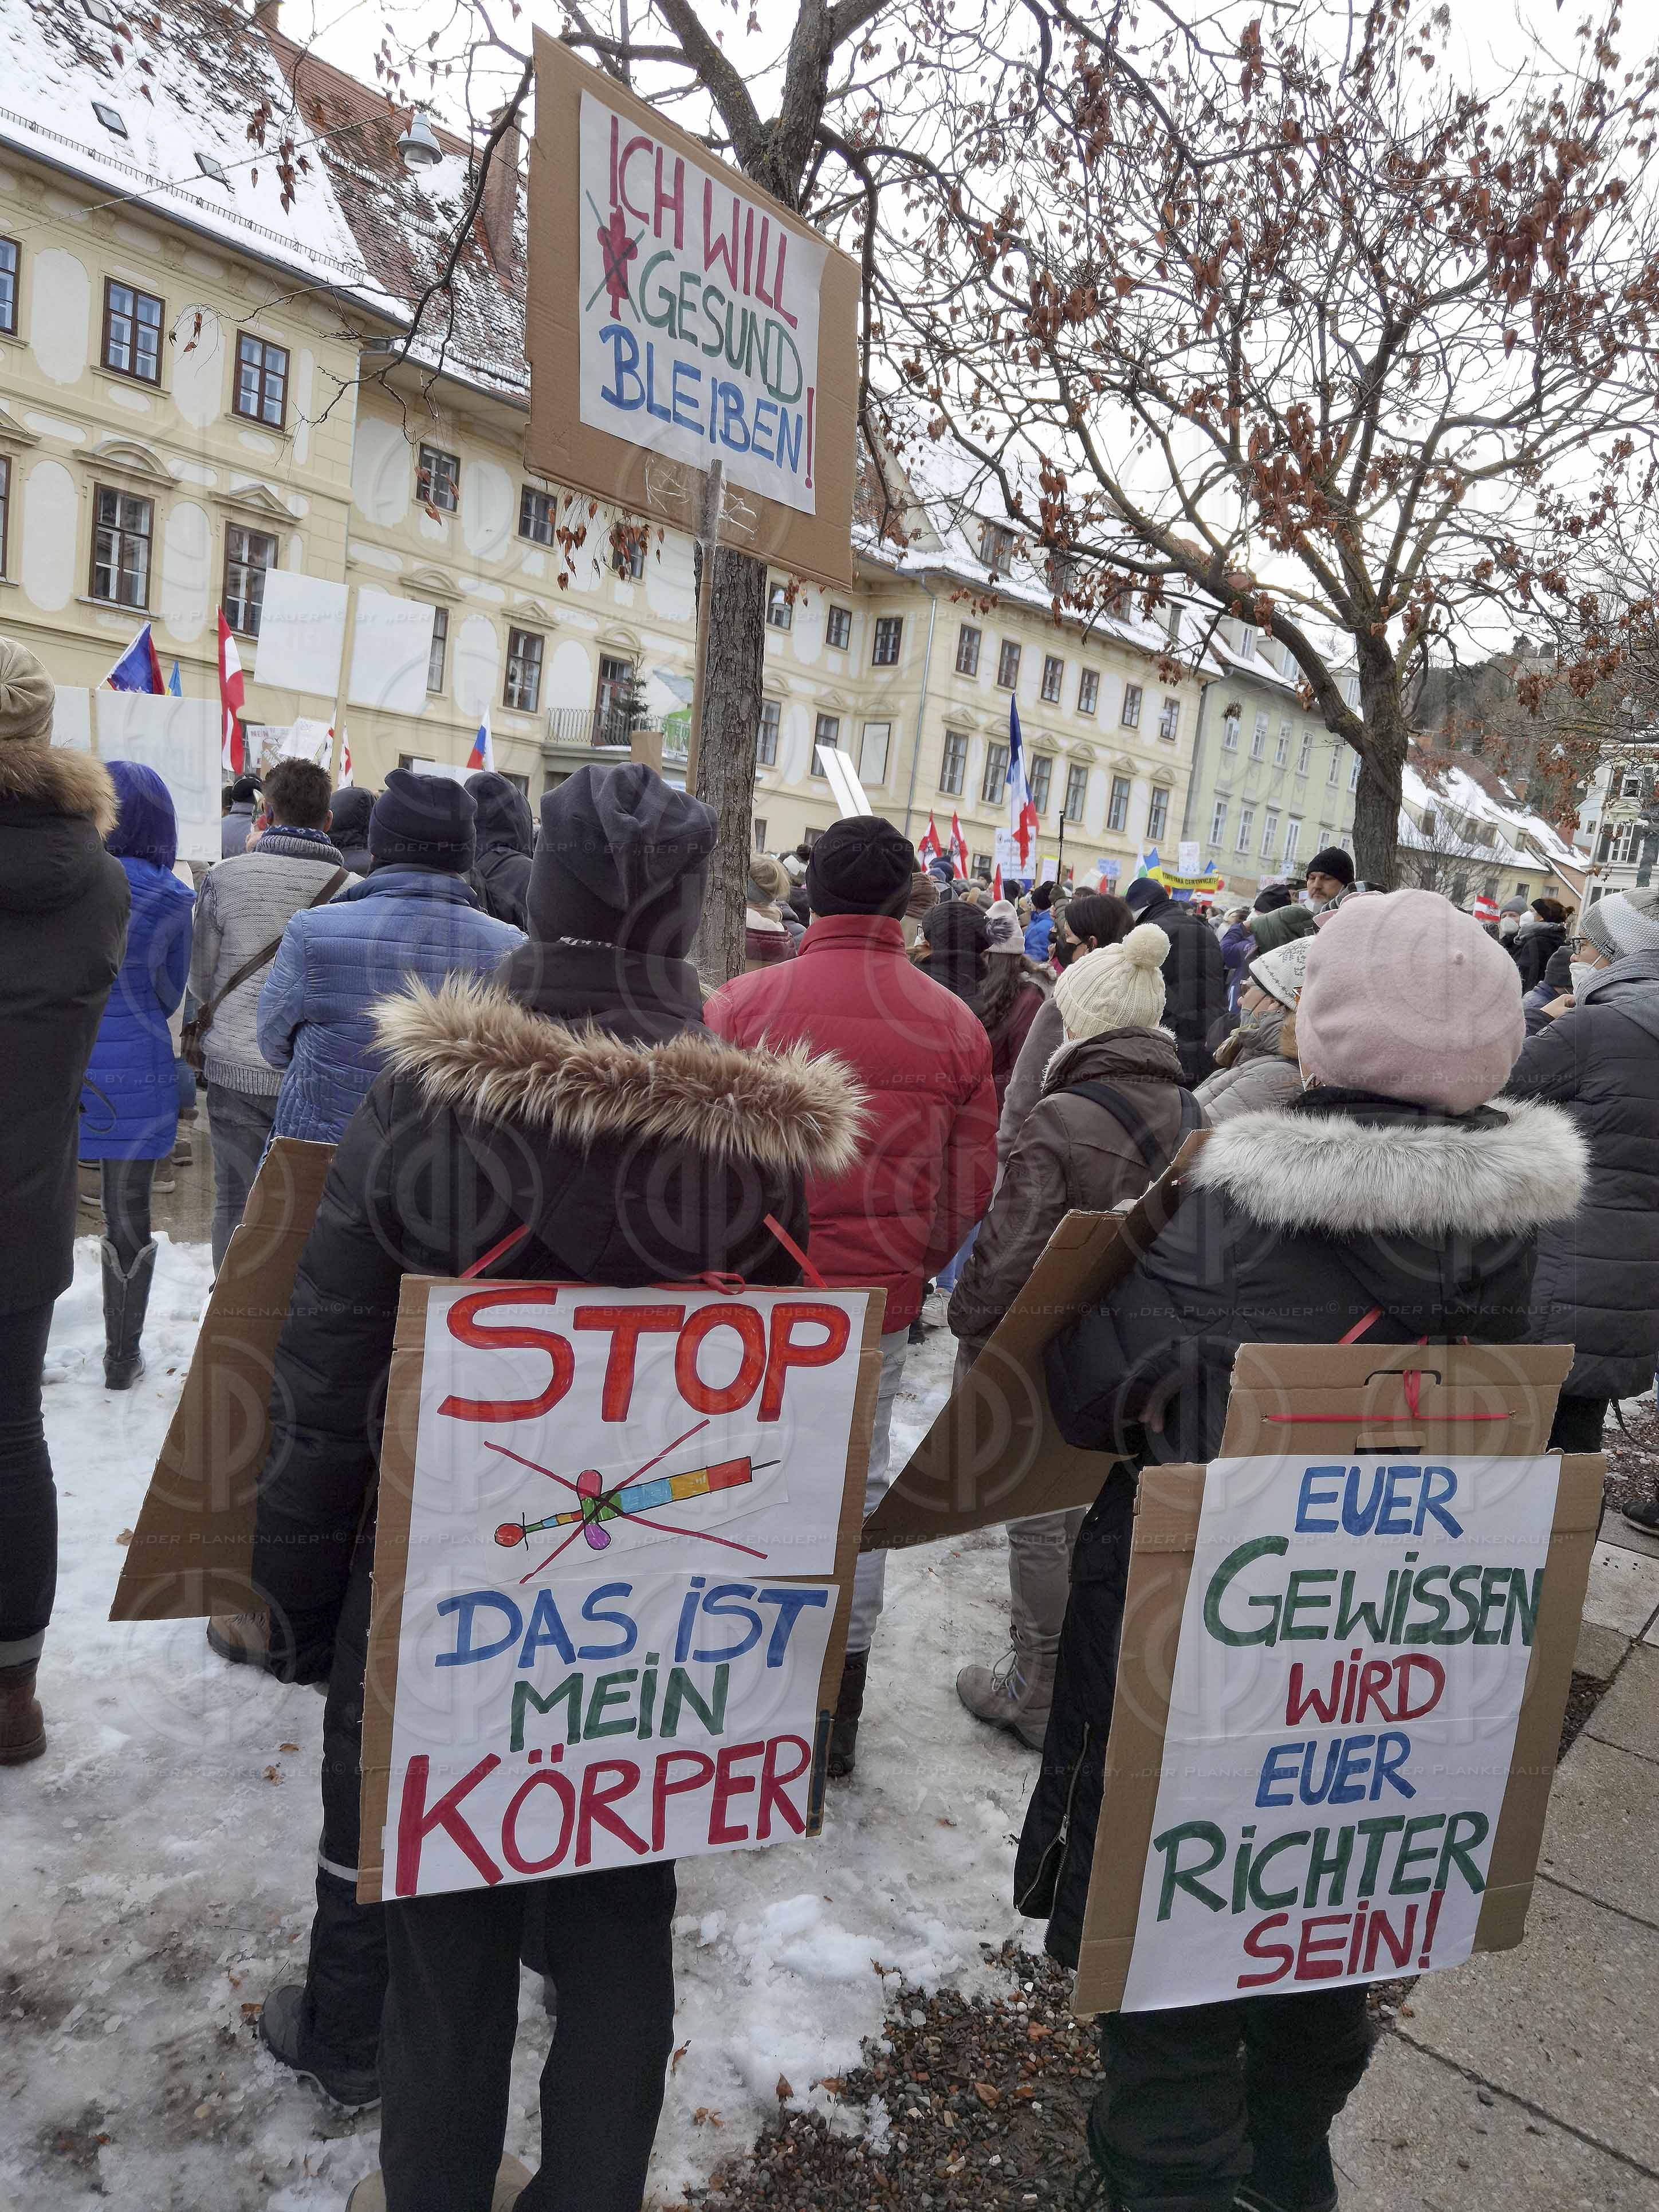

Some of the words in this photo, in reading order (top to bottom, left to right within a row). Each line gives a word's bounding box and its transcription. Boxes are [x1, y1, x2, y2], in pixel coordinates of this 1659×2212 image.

[611, 115, 684, 250] ICH
[703, 178, 798, 329] WILL
[639, 250, 803, 403] GESUND
[438, 1287, 850, 1423] STOP
[1295, 1465, 1464, 1537] EUER
[435, 1582, 638, 1668] DAS
[1255, 1732, 1416, 1808] EUER
